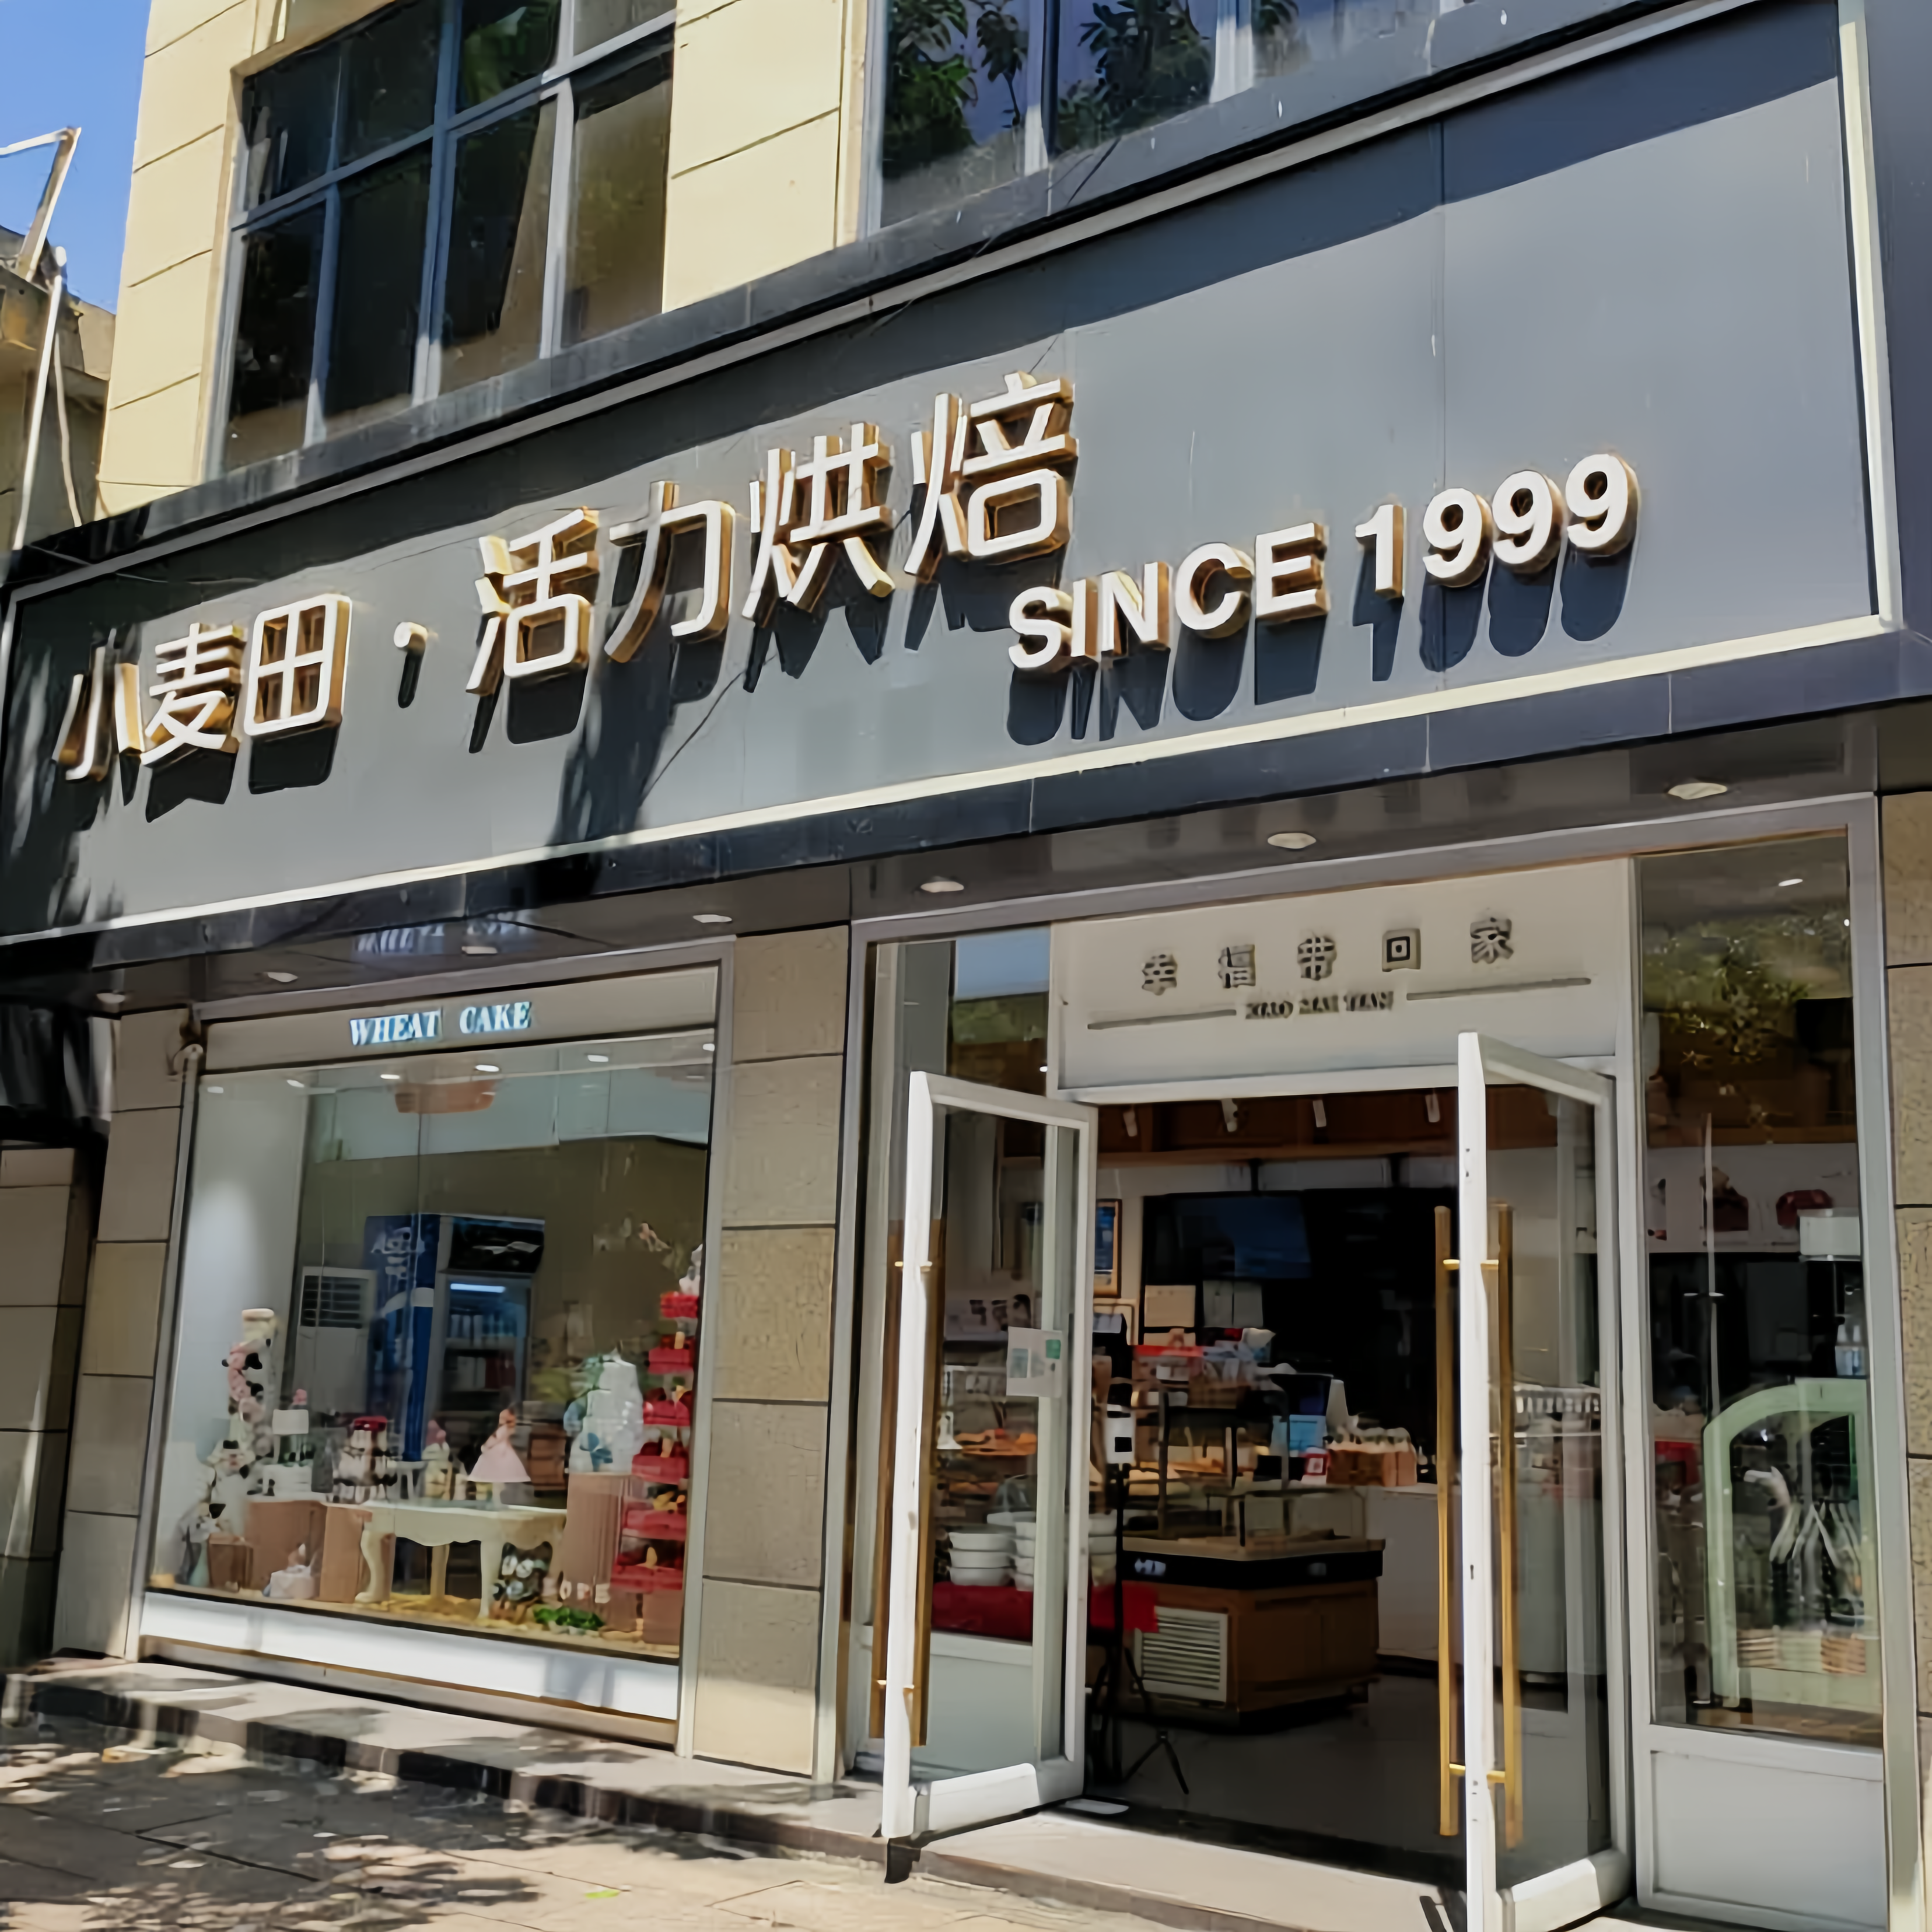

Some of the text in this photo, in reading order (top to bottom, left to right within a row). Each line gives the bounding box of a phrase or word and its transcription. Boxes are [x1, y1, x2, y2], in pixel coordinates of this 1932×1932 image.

[1008, 453, 1638, 672] SINCE 1999
[350, 1001, 533, 1045] WHEAT CAKE
